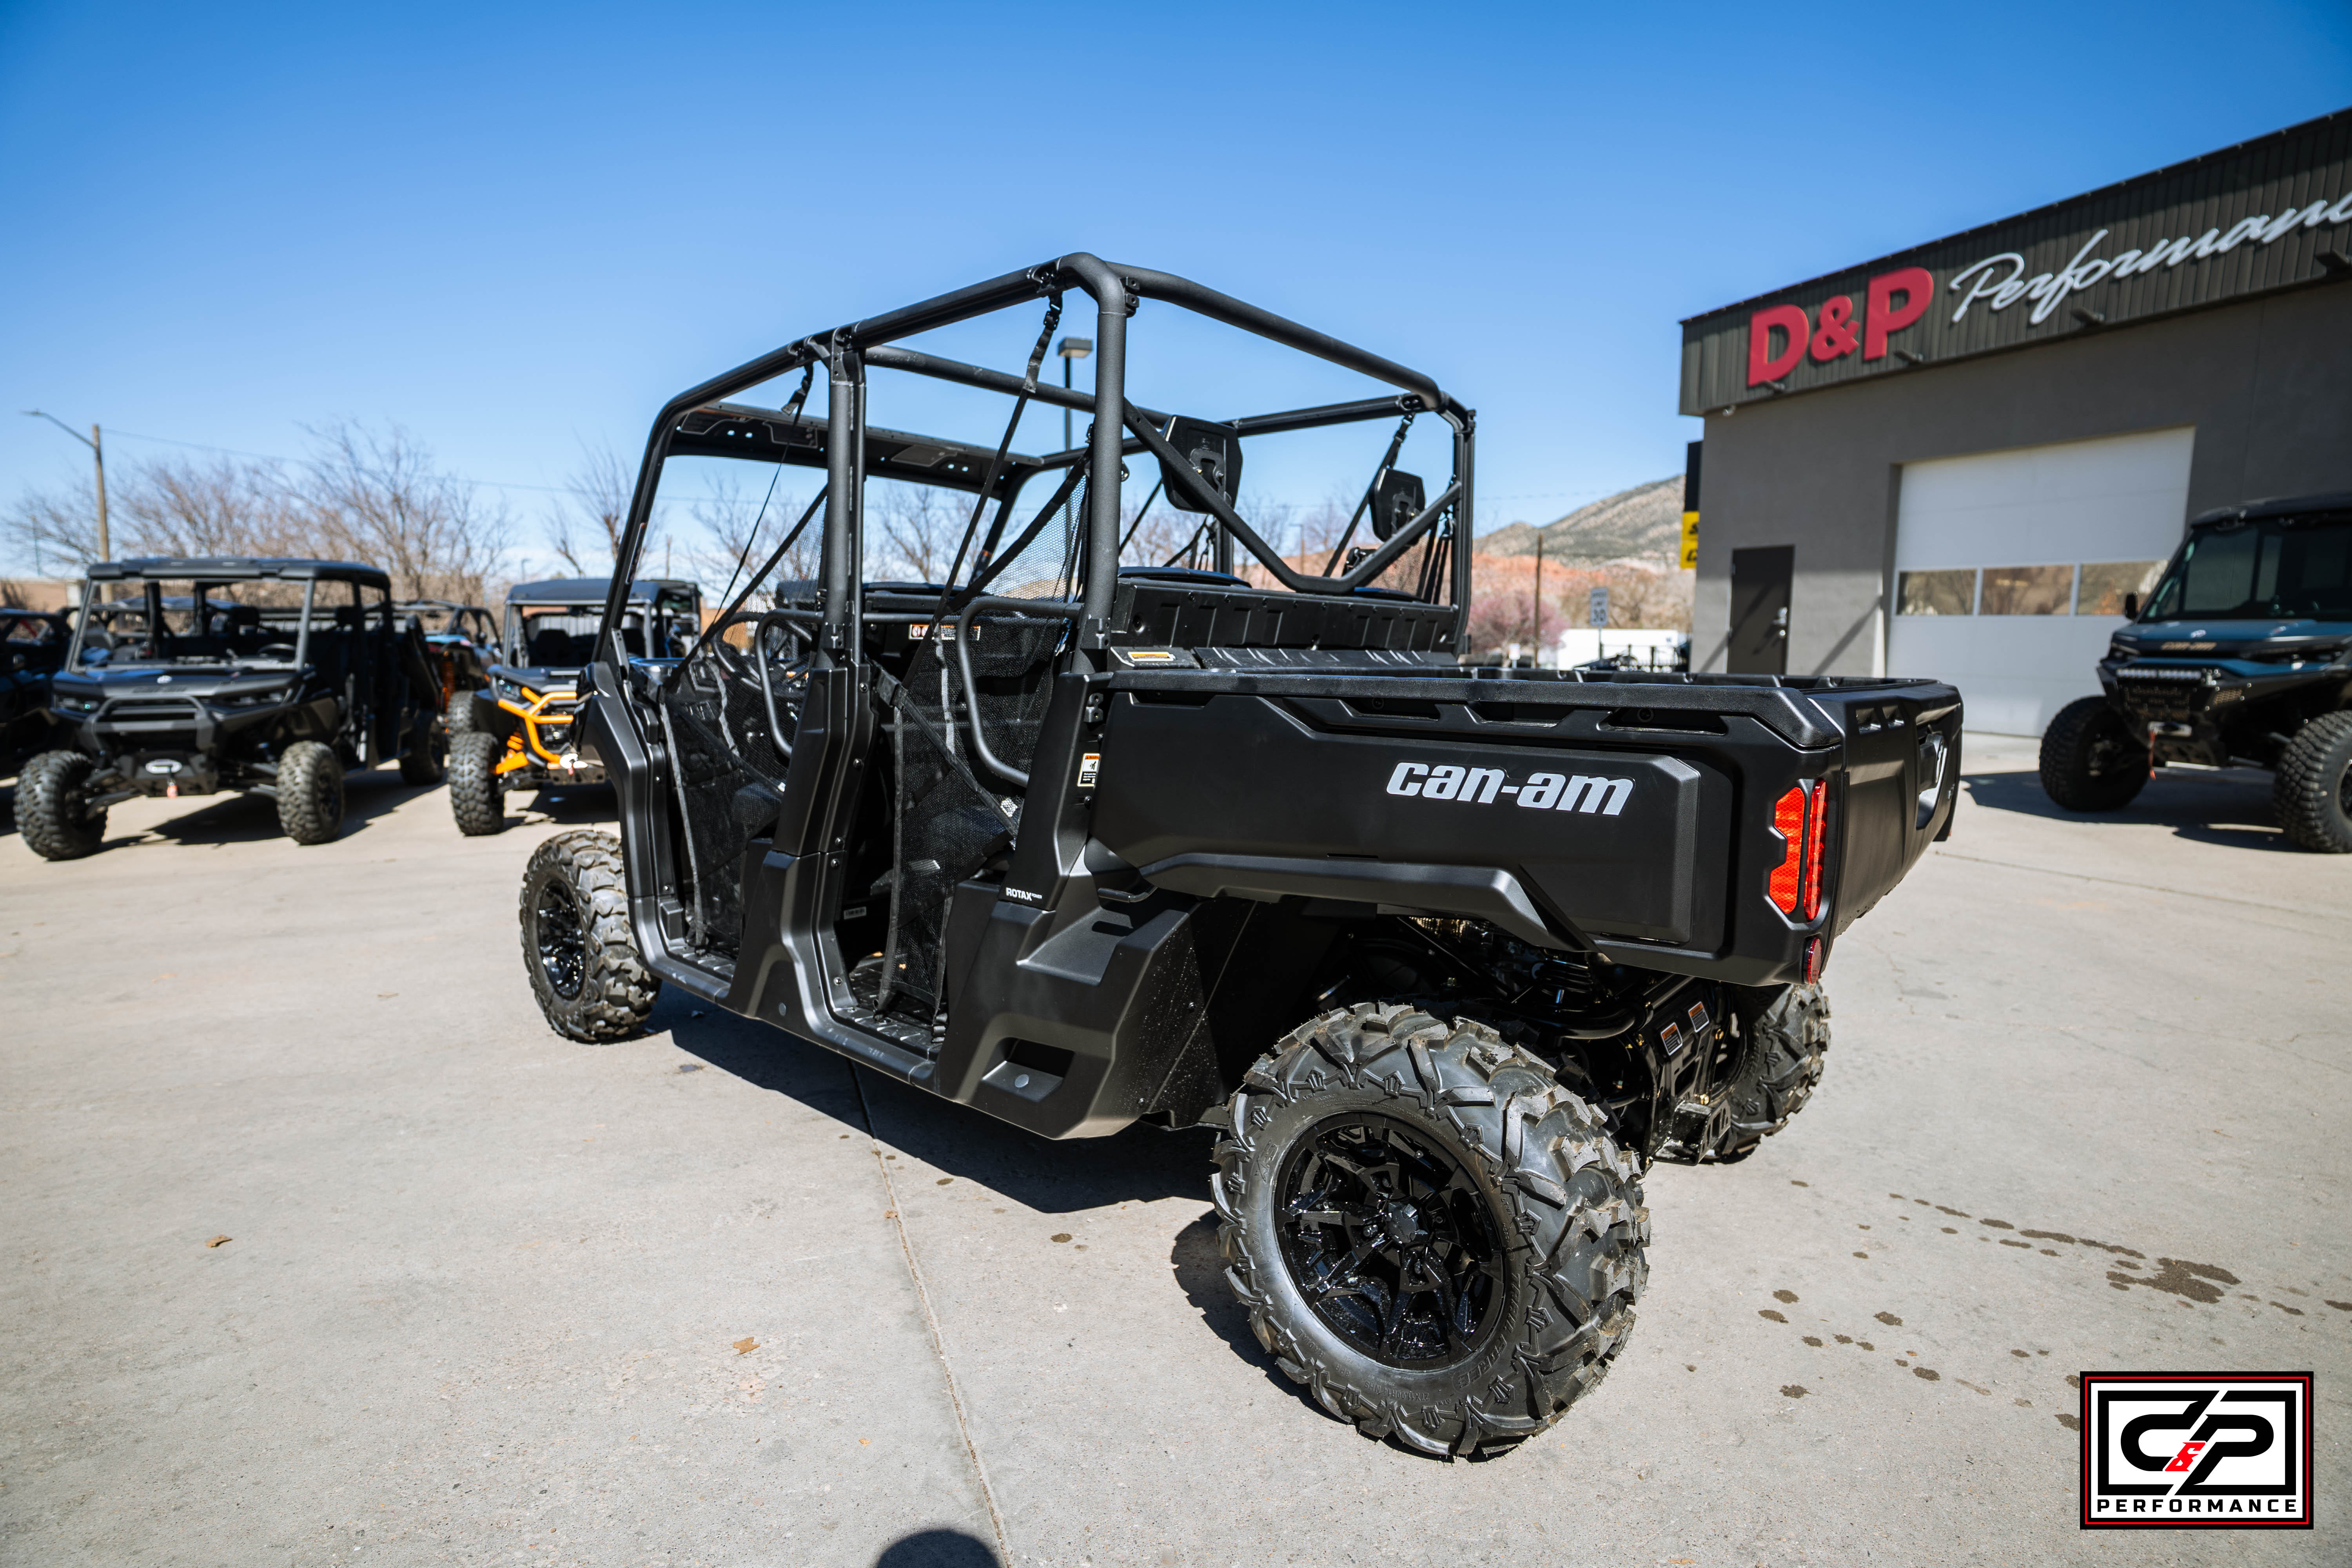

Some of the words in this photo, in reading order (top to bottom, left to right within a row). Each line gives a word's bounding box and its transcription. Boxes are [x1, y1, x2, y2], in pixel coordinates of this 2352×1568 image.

[1748, 267, 1934, 387] D&P
[1387, 762, 1634, 815] can-am
[1006, 888, 1032, 901] ROTAX
[1458, 1334, 1507, 1389] FORCE
